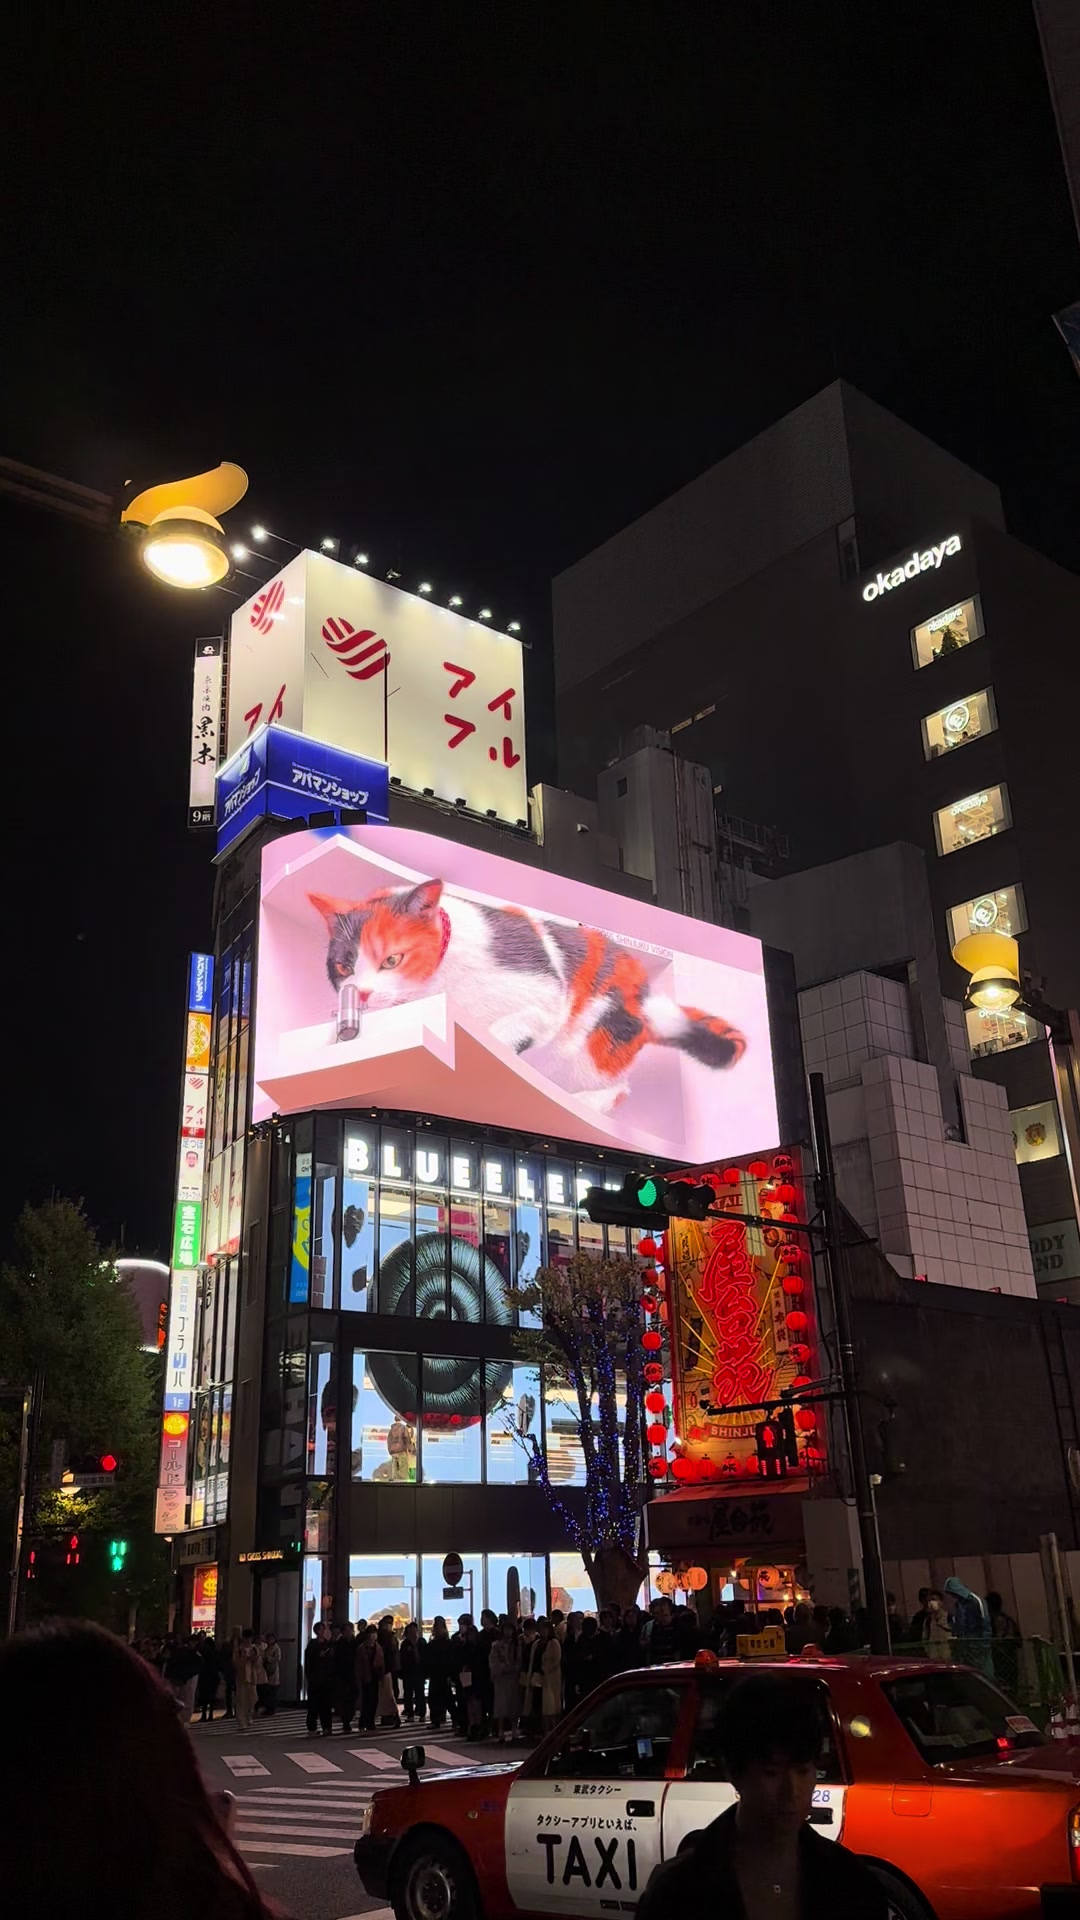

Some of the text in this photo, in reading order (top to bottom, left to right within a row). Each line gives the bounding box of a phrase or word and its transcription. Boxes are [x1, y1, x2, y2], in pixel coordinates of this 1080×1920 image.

[862, 533, 962, 602] okadaya
[193, 716, 216, 765] 黒木
[291, 768, 369, 806] アパマンショップ
[616, 935, 650, 952] SHINJUKU
[650, 945, 674, 958] VISION
[179, 1205, 197, 1266] 宝石広場
[173, 1316, 189, 1388] ブラリバ
[172, 1396, 184, 1407] 1F
[573, 1784, 622, 1794] 東武タクシー
[537, 1813, 638, 1831] タクシーアプリといえば、
[536, 1833, 638, 1892] TAXI
